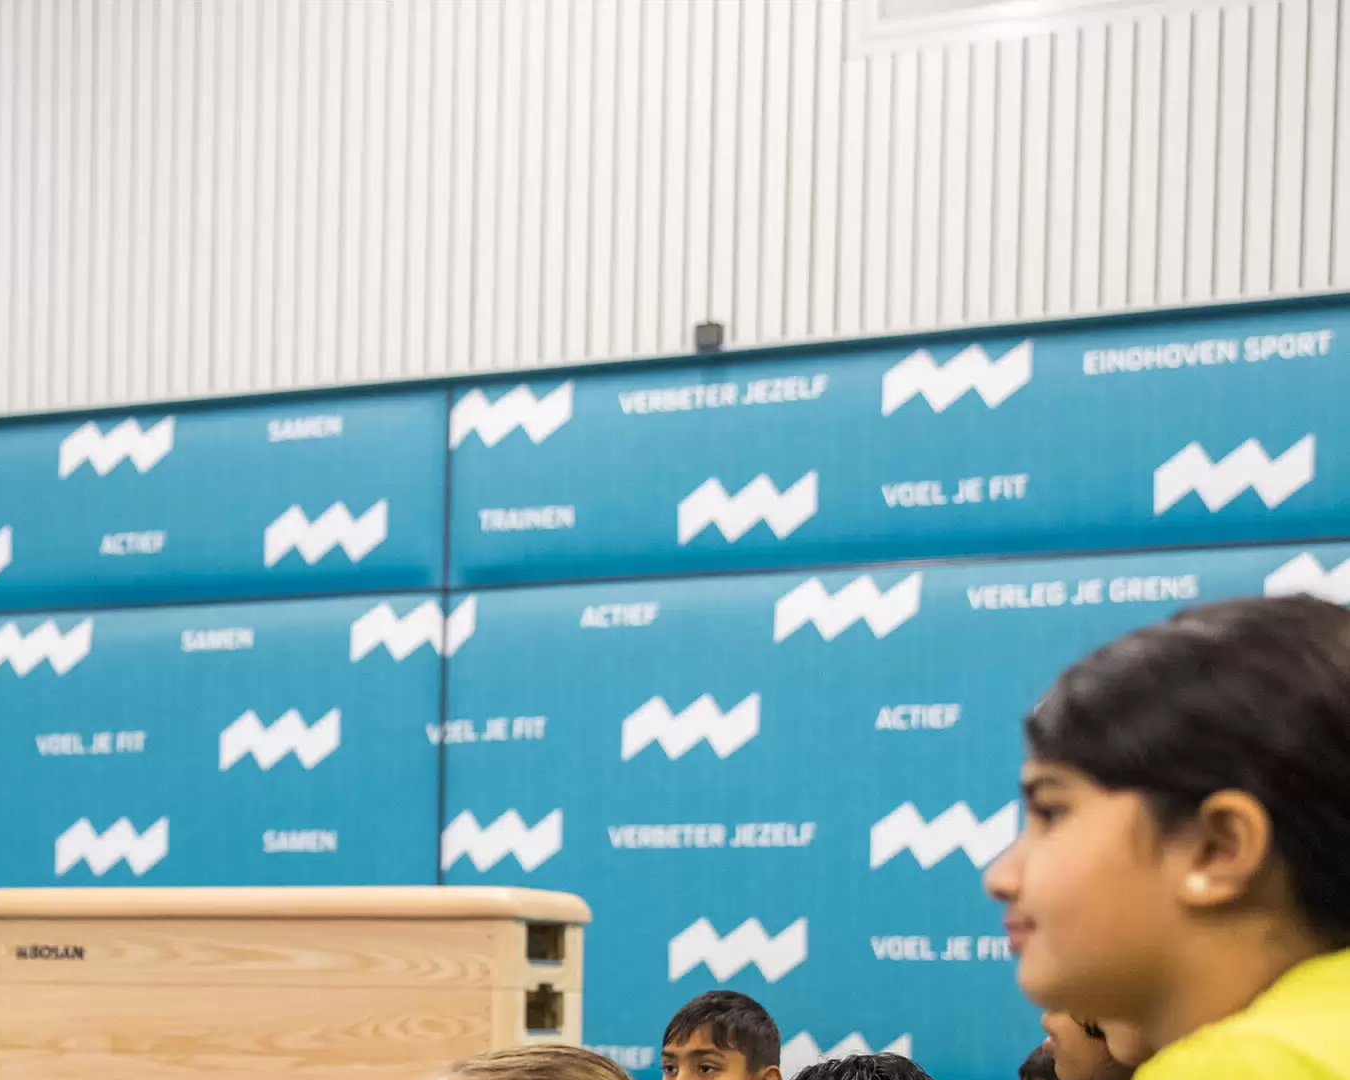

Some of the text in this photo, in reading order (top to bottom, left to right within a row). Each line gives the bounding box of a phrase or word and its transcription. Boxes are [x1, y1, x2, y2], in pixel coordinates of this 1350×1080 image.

[1082, 329, 1335, 376] EINDHOVEN SPORT
[618, 373, 829, 414] VERBETER JEZELF
[267, 414, 343, 442] SAMEN
[881, 474, 1029, 508] VOEL JE FIT
[478, 505, 575, 532] TRAINEN
[99, 531, 167, 556] ACTIEF
[966, 575, 1198, 610] VERLEG JE GRENS
[579, 602, 660, 629] ACTIEF
[181, 627, 254, 653] SAMEN
[480, 718, 509, 742] JE
[512, 716, 547, 740] FIT
[875, 704, 962, 731] ACTIEF
[35, 730, 147, 756] VOEL JE FIT
[263, 830, 338, 854] SAMEN
[608, 822, 817, 849] VERBETER JEZELF
[31, 945, 85, 960] BOSAN
[870, 935, 937, 961] VOEL
[940, 935, 973, 961] JE
